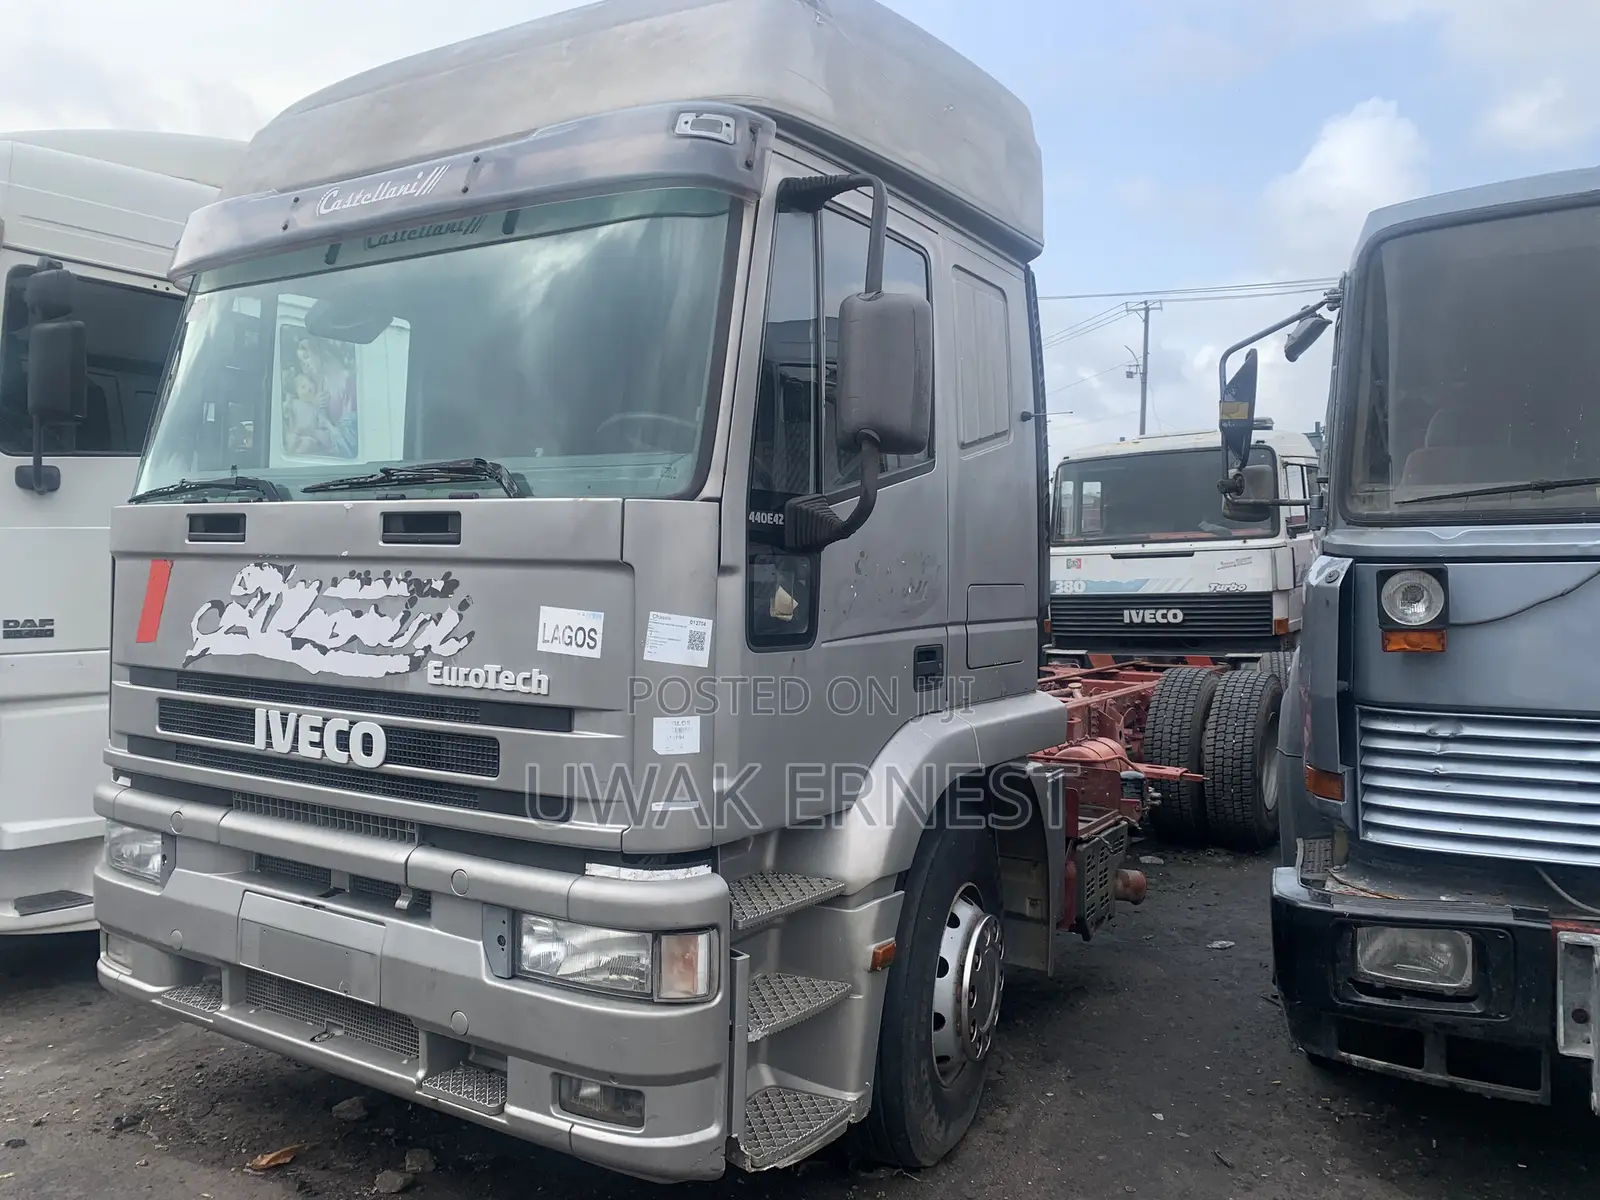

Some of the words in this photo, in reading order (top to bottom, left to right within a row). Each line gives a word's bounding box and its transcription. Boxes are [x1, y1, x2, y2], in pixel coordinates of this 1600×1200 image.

[316, 172, 424, 216] Castellani
[748, 511, 784, 525] 440E42
[1055, 581, 1086, 593] 380
[1208, 582, 1247, 593] Turbo
[3, 618, 54, 629] DAF
[1122, 609, 1184, 624] IVECO
[542, 622, 598, 650] LAGOS
[427, 660, 550, 695] EuroTech
[254, 708, 387, 769] IVECO
